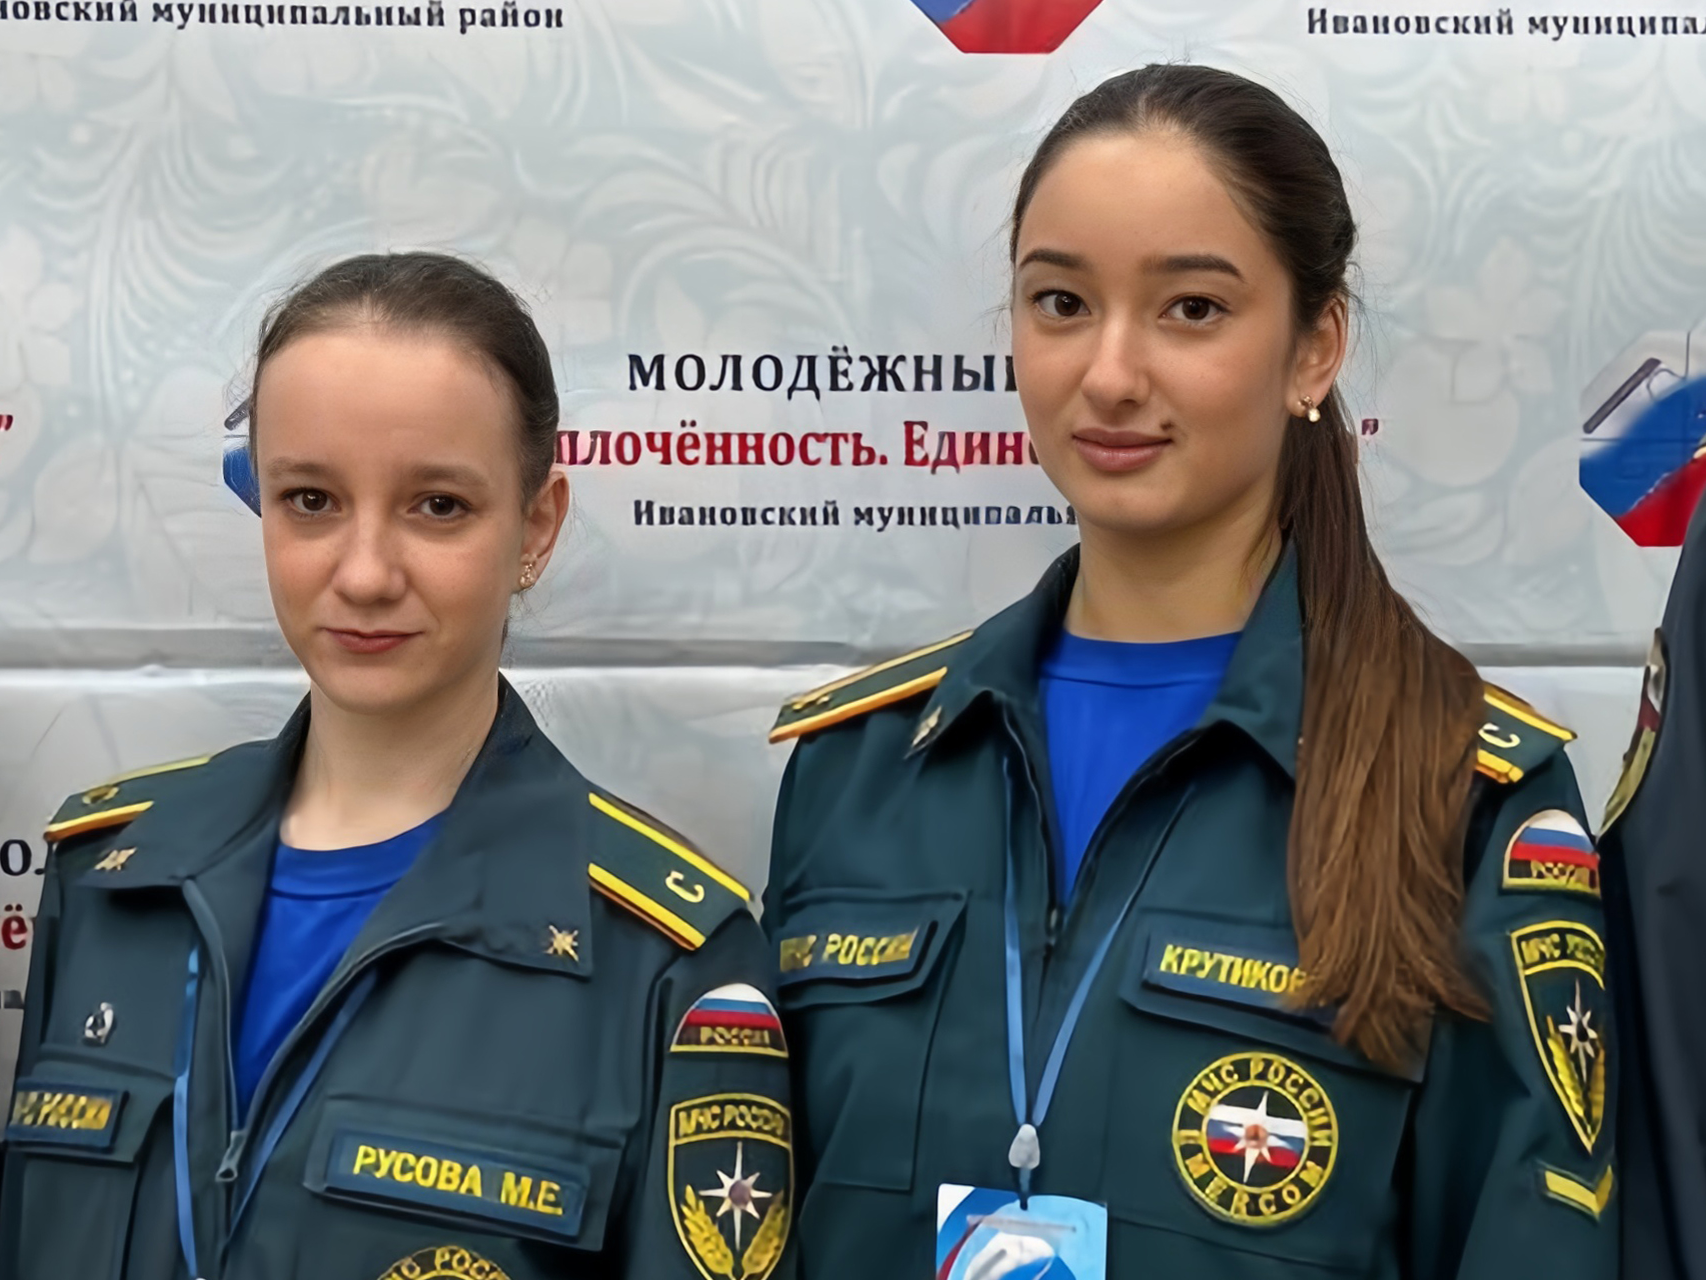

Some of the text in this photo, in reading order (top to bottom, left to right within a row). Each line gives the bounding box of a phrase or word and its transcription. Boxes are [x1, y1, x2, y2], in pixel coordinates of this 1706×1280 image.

[459, 1, 562, 34] район
[1308, 8, 1513, 35] Ивановский
[555, 420, 888, 466] плочённость.
[352, 1144, 482, 1198] РУСОВА
